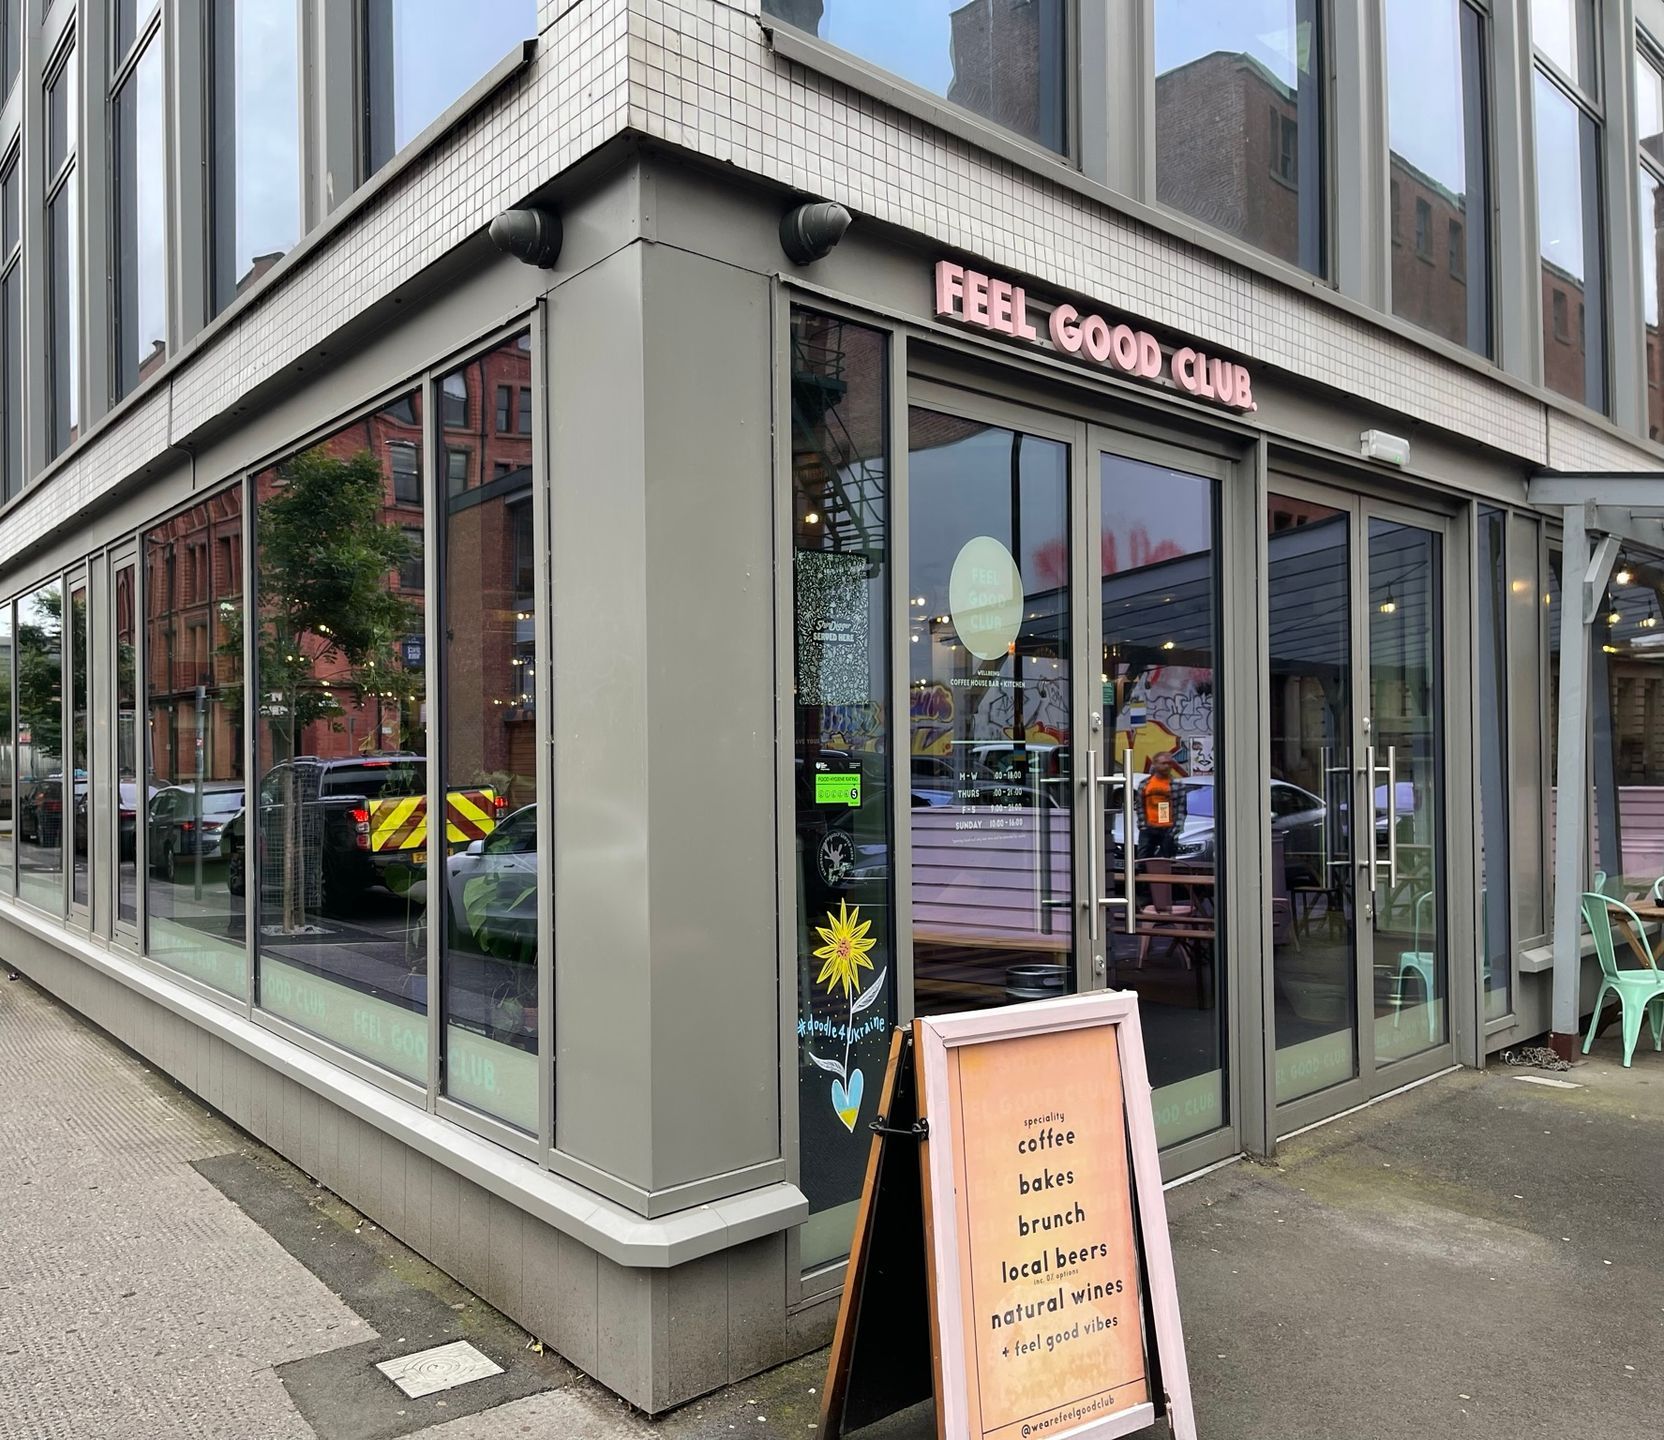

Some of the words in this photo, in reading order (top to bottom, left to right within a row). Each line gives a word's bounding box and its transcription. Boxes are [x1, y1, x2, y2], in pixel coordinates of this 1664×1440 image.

[935, 260, 1036, 342] FEEL
[1050, 304, 1162, 379] GOOD
[972, 567, 1000, 586] FEEL
[968, 589, 1006, 608] GOOD
[813, 632, 837, 641] SERVED
[838, 633, 854, 642] HERE
[950, 678, 970, 686] COFFEE
[970, 679, 988, 687] HOUSE
[988, 680, 1000, 688] BAR
[1003, 681, 1026, 689] KITCHEN
[957, 789, 980, 798] THURS
[955, 820, 983, 830] SUNDAY
[1024, 1112, 1065, 1129] speciality
[1018, 1127, 1075, 1154] coffee
[1019, 1168, 1074, 1195] bakes
[1018, 1201, 1086, 1237] brunch
[1002, 1250, 1048, 1283] local
[1056, 1243, 1107, 1269] beers
[1056, 1268, 1079, 1281] options
[991, 1287, 1064, 1330] natural
[1071, 1279, 1123, 1305] wines
[1002, 1346, 1010, 1358] +
[1014, 1333, 1041, 1357] feel
[1046, 1322, 1079, 1352] good
[1084, 1316, 1119, 1335] vibes
[1021, 1394, 1115, 1439] @wearefeelgoodclub
